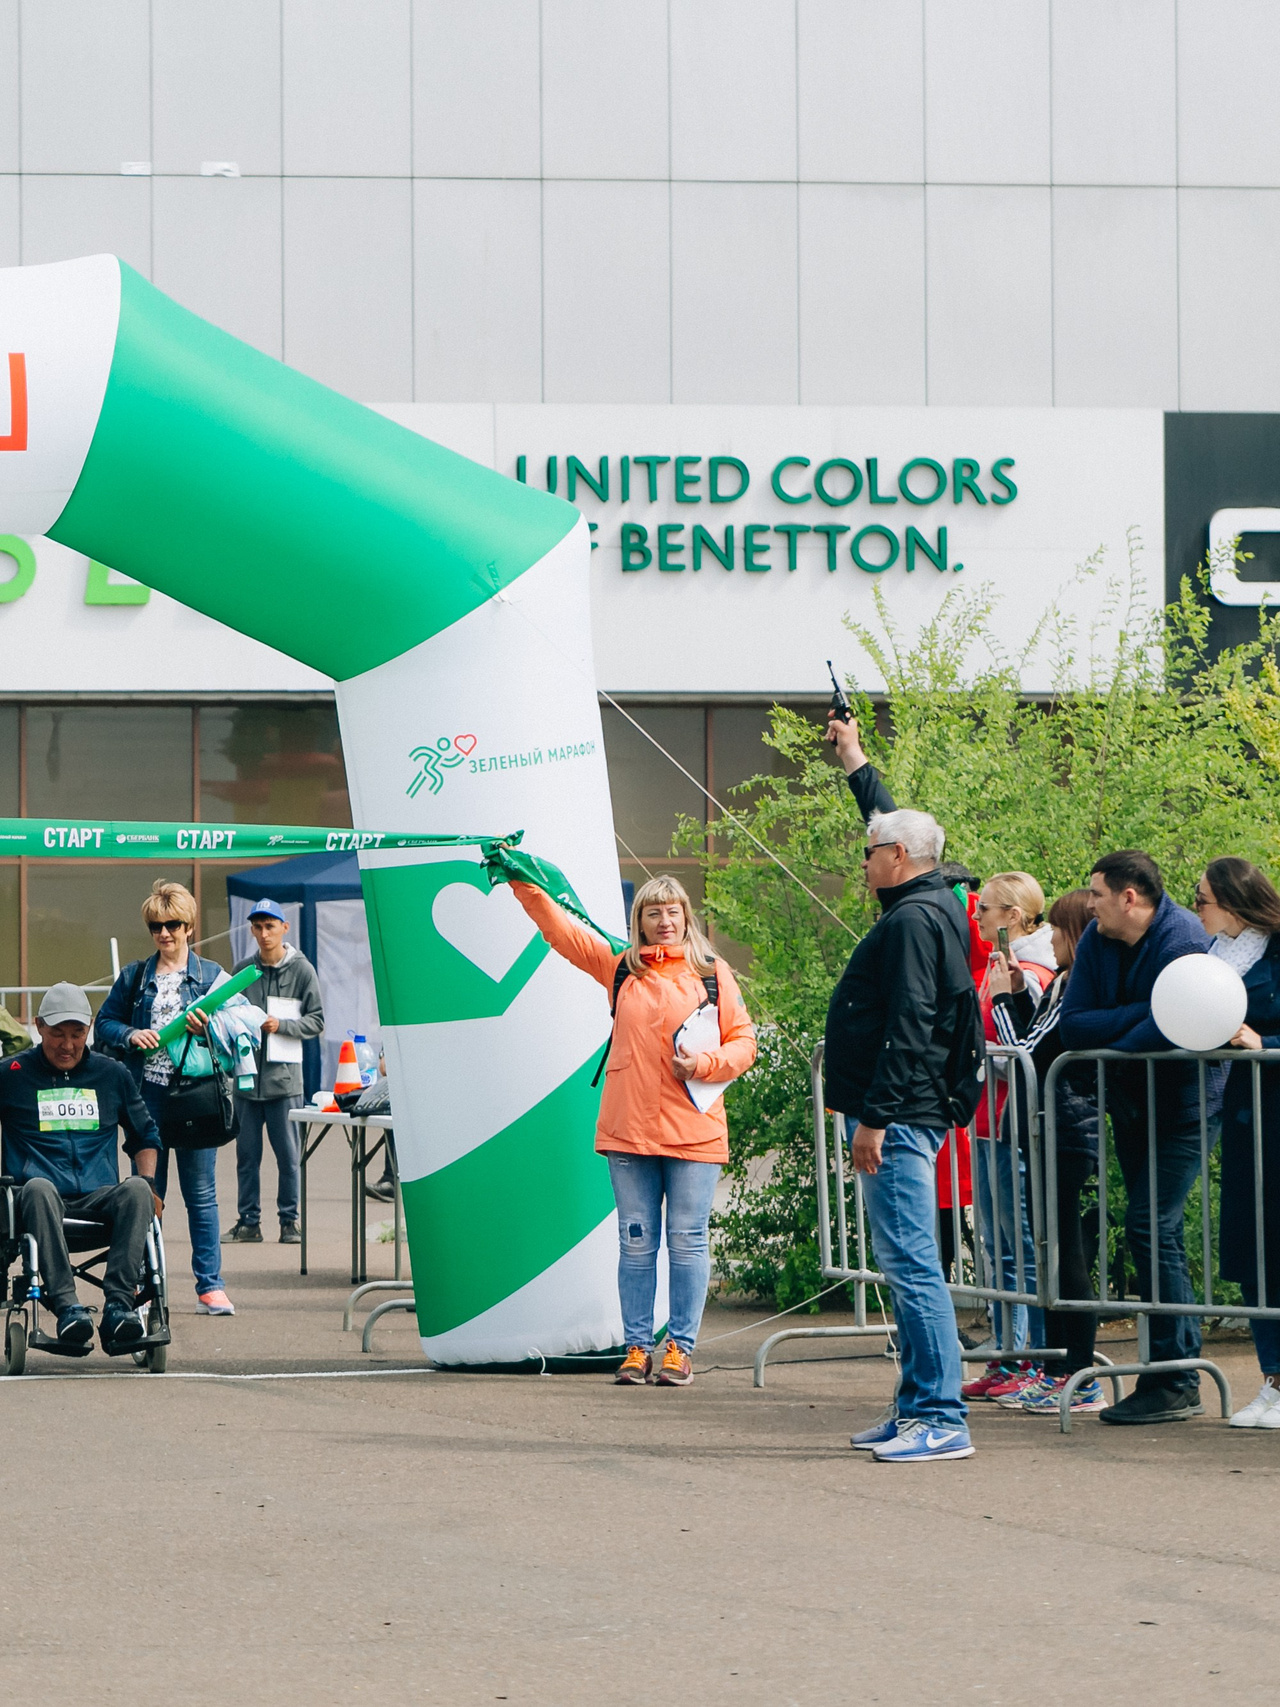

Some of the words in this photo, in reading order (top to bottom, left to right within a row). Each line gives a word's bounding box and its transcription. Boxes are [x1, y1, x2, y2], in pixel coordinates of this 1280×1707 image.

[516, 455, 750, 504] UNITED
[771, 456, 1018, 506] COLORS
[621, 523, 965, 573] BENETTON.
[469, 748, 544, 774] ЗЕЛЕНЫЙ
[548, 740, 596, 763] МАРАФОН
[44, 827, 105, 848] СТАРТ
[177, 829, 236, 850] СТАРТ
[326, 832, 386, 850] СТАРТ
[57, 1103, 95, 1117] 0619
